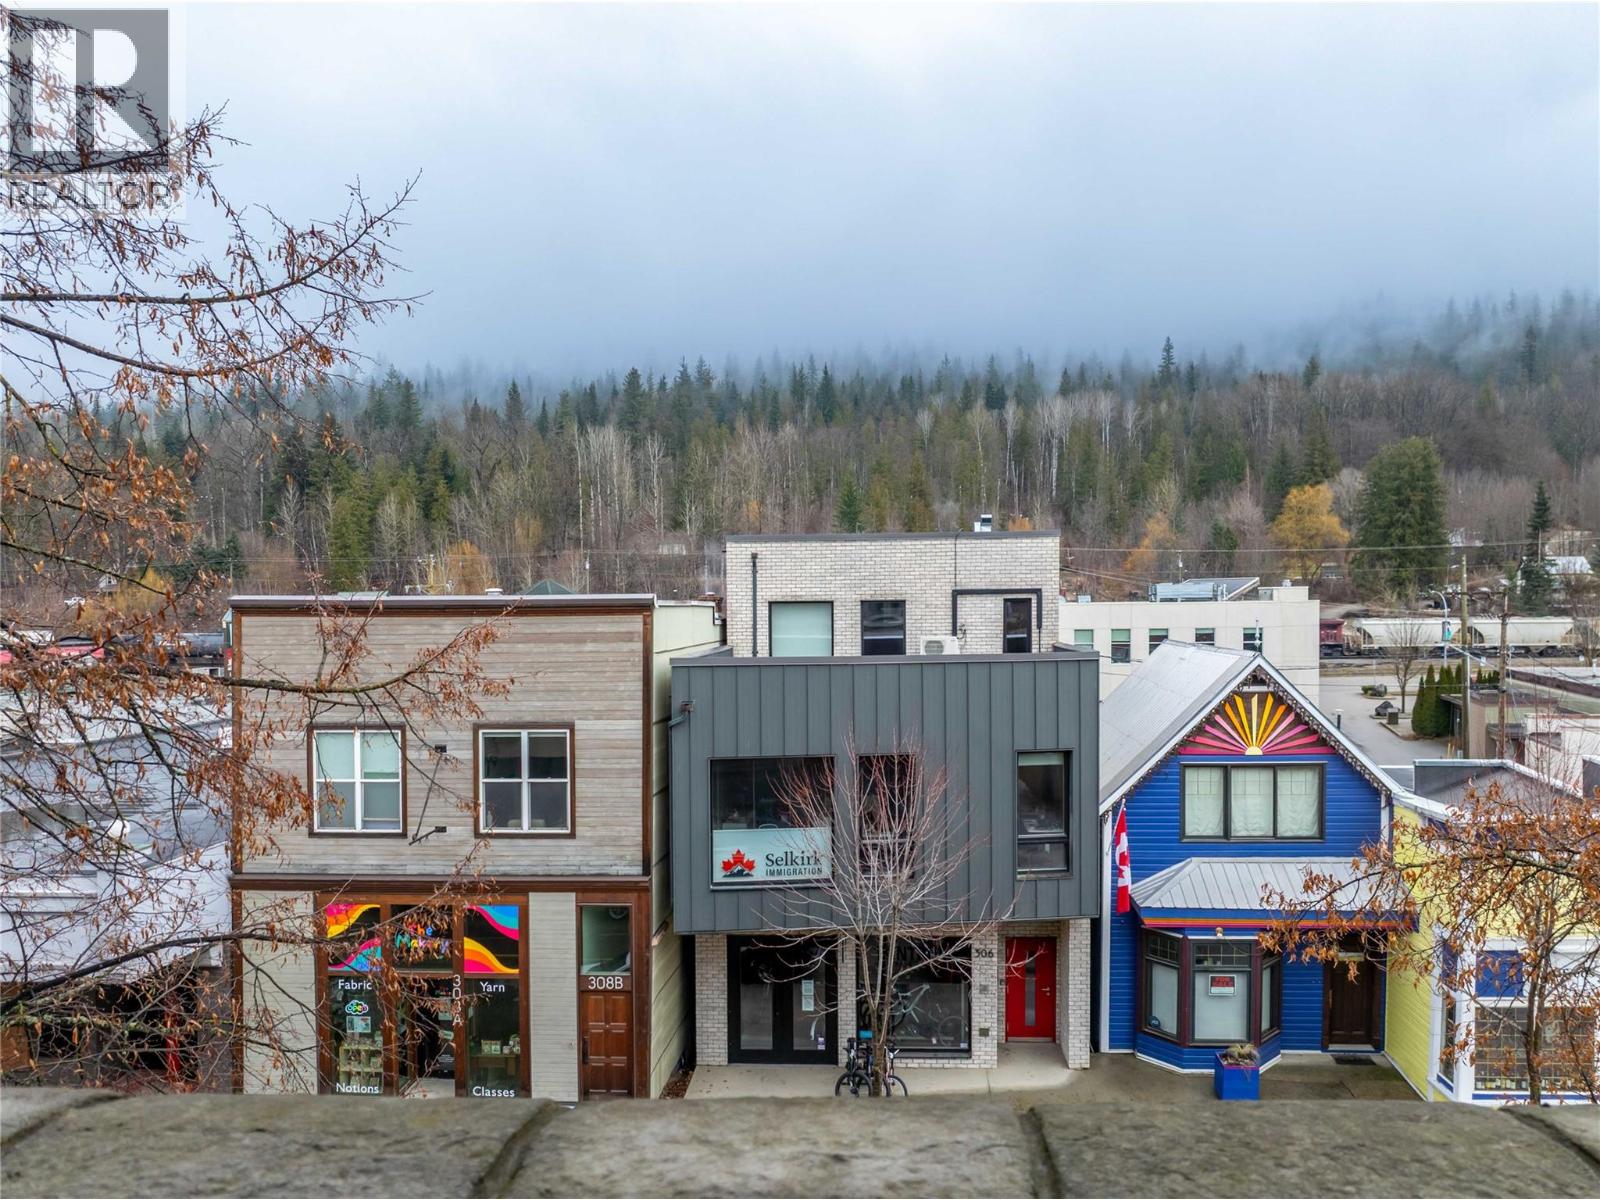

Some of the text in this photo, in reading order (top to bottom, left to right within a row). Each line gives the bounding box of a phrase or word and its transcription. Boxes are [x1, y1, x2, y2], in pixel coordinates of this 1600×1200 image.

[765, 850, 822, 867] Selkirk
[765, 867, 823, 877] IMMIGRATION
[338, 979, 373, 990] Fabric
[480, 981, 505, 993] Yarn
[587, 976, 624, 990] 308B
[335, 1082, 380, 1094] Notions
[472, 1086, 515, 1098] Classes
